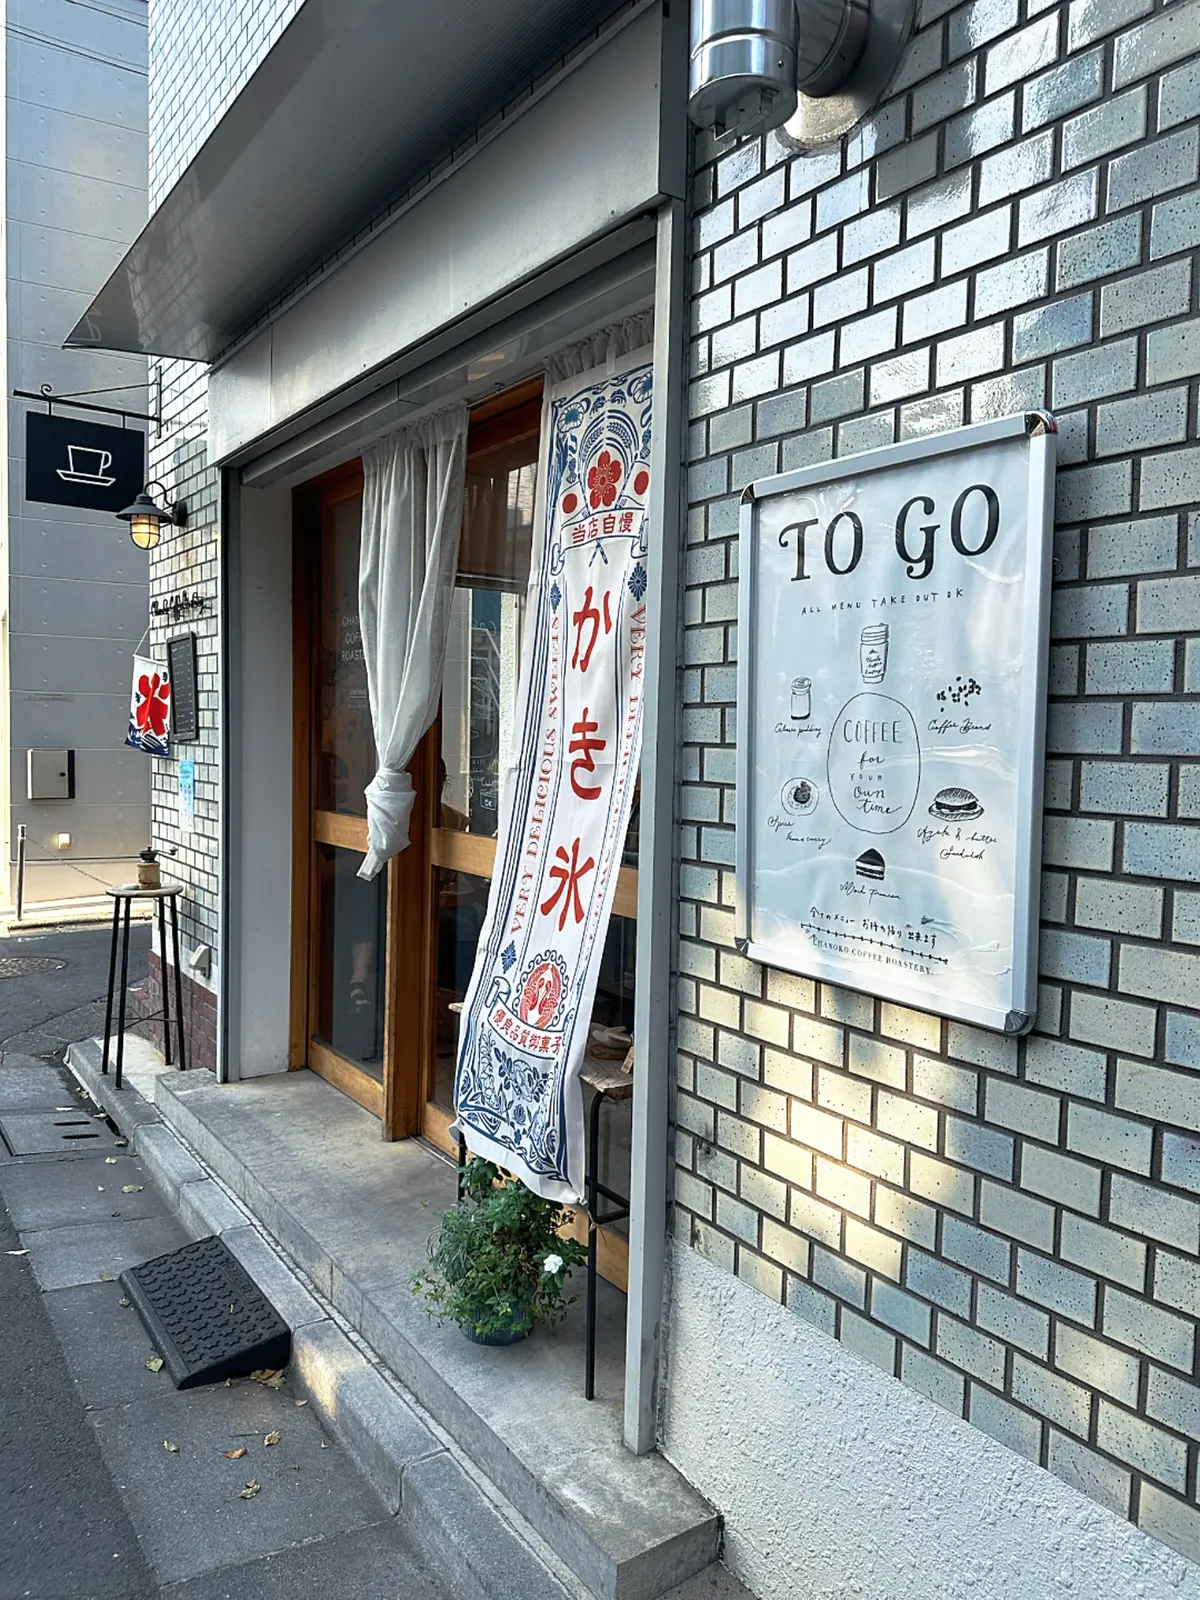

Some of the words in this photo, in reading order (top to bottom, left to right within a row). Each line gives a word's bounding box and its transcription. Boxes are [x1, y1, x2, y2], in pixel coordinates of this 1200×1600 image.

[571, 512, 634, 544] 当店自慢
[778, 511, 864, 582] TO
[894, 483, 1001, 580] GO
[801, 606, 822, 616] ALL
[831, 601, 862, 611] MENU
[871, 595, 907, 609] TAKE
[915, 592, 939, 603] OUT
[947, 588, 964, 599] OK
[630, 603, 647, 683] VERY
[843, 719, 903, 744] COFFEE
[540, 585, 612, 932] かき氷
[856, 750, 886, 770] for
[511, 873, 535, 934] VERY
[526, 727, 558, 858] DELICIOUS
[548, 615, 560, 720] SWEETS
[849, 773, 884, 782] YOUR
[856, 798, 902, 815] time
[851, 947, 883, 963] COFFEE
